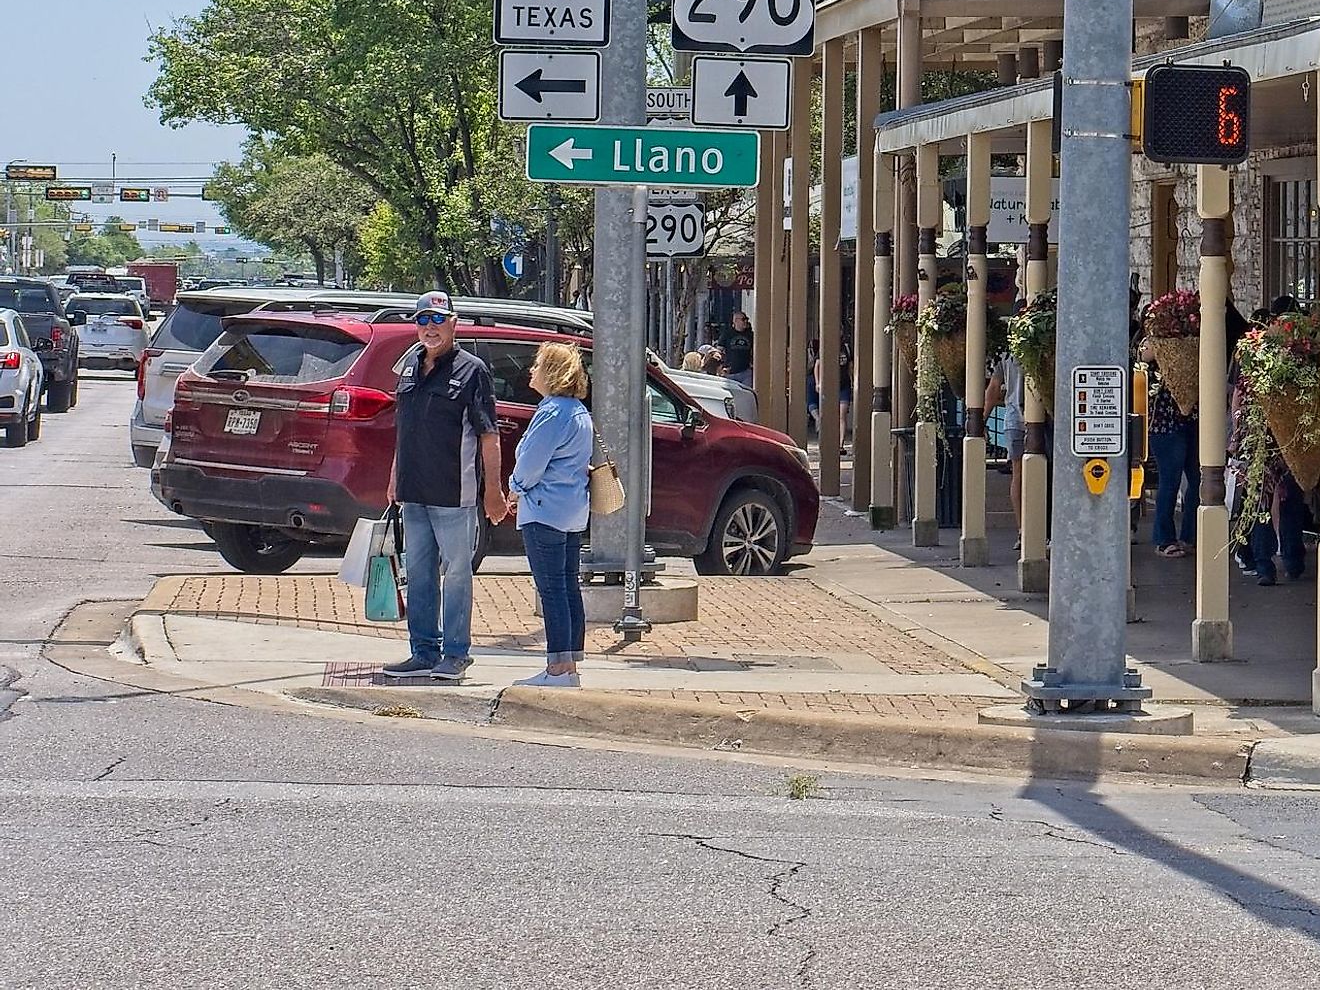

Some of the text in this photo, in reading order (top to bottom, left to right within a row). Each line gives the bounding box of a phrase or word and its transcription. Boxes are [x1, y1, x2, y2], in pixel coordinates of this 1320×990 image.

[512, 6, 593, 29] TEXAS
[1218, 86, 1240, 146] 6
[613, 138, 723, 175] Llano
[646, 214, 697, 243] 290
